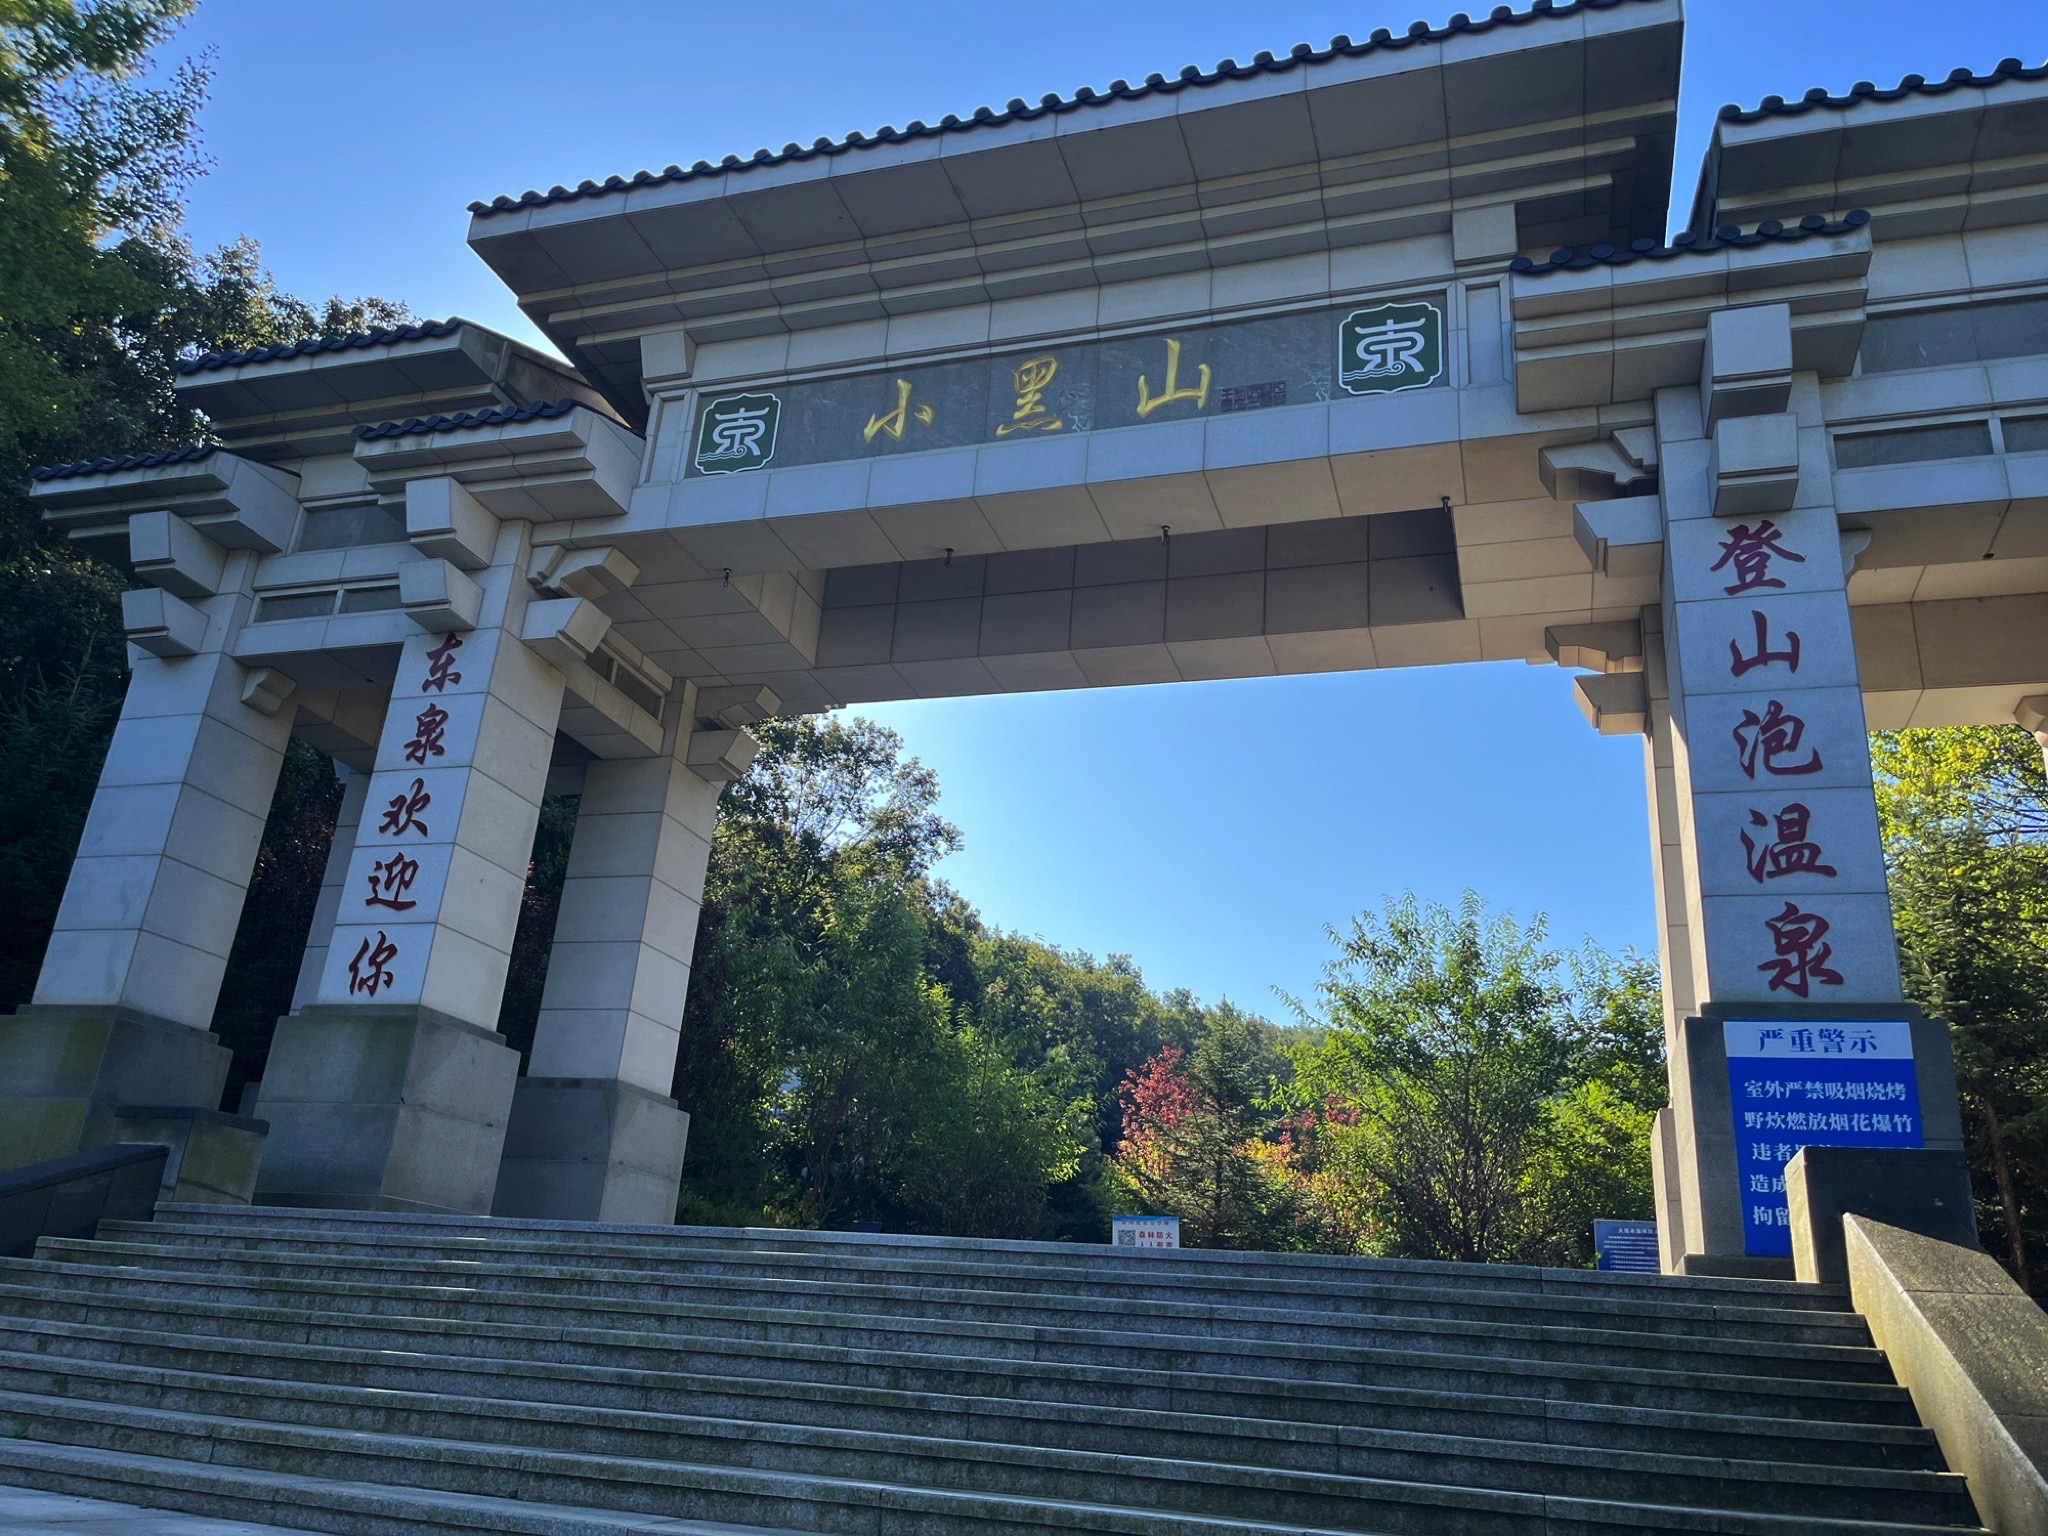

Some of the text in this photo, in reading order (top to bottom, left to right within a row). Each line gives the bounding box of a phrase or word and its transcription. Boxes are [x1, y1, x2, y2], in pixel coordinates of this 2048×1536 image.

[864, 338, 1211, 441] 小黑山
[1711, 519, 1844, 998] 登山泡温泉
[349, 633, 463, 997] 东泉欢迎你
[1759, 1028, 1878, 1055] 严重警示
[1744, 1081, 1907, 1102] 室外严禁吸烟烧烤
[1744, 1111, 1913, 1134] 野炊燃放烟花爆竹
